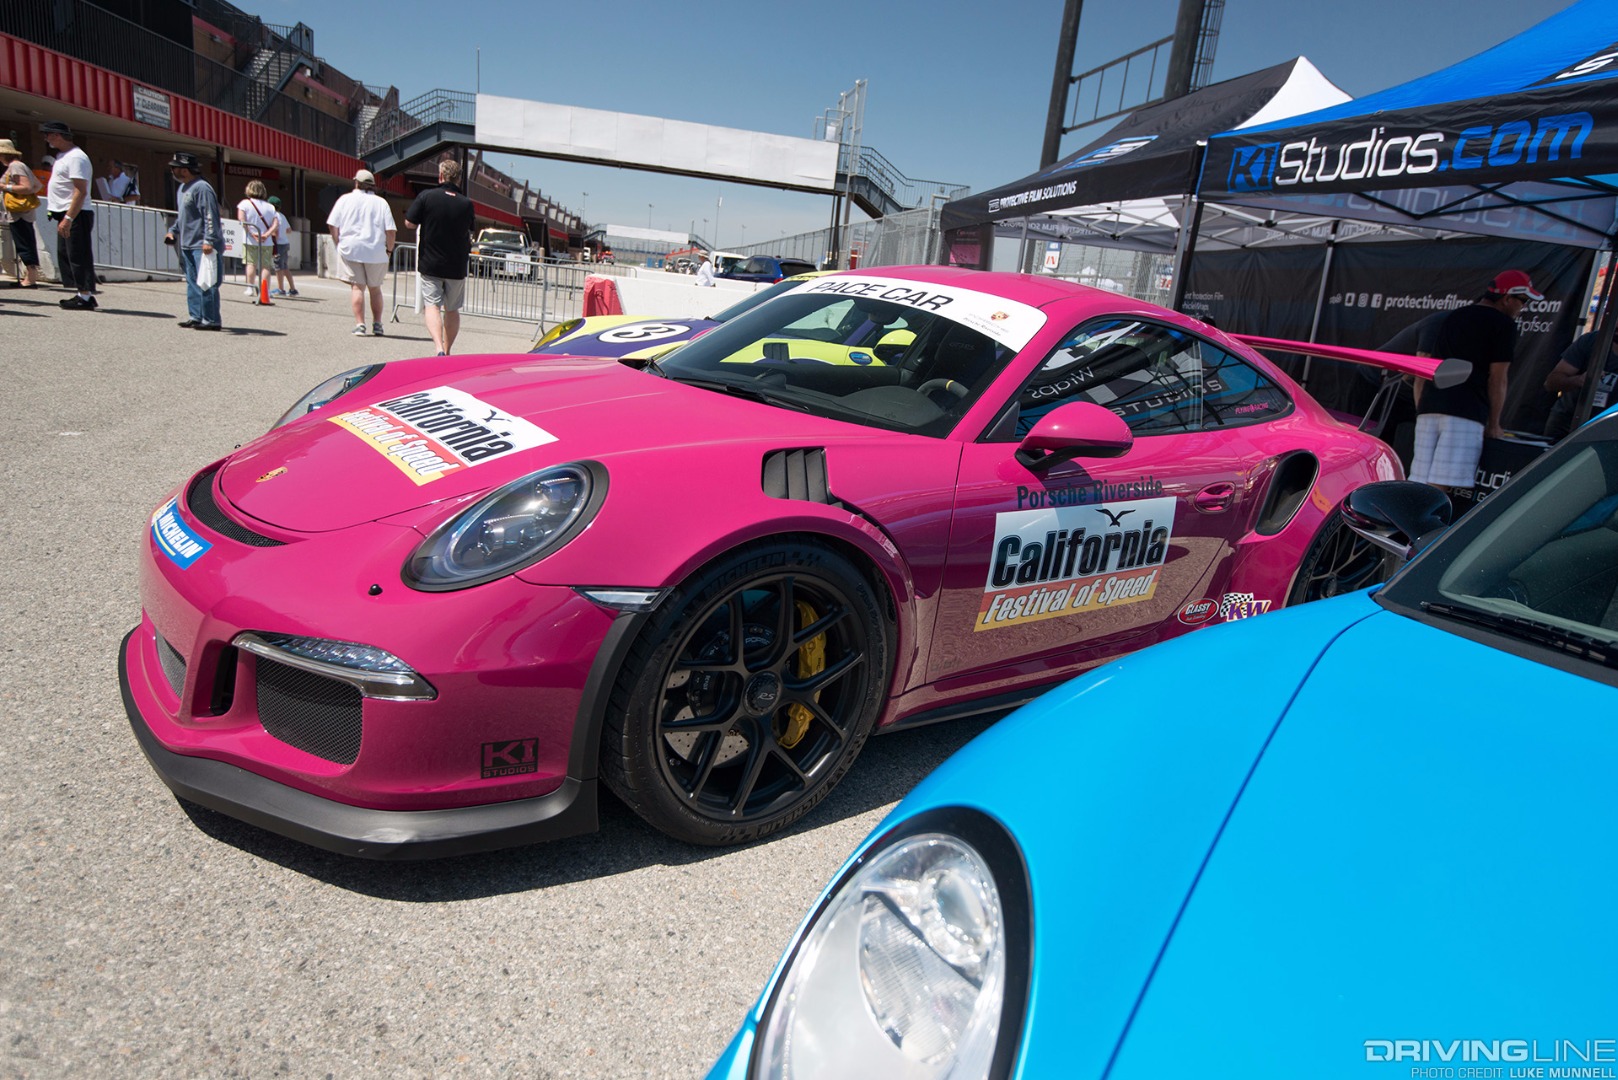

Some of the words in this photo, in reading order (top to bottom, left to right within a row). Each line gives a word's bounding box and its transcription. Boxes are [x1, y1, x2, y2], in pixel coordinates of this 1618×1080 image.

[228, 165, 263, 177] SECURITY
[1000, 191, 1029, 209] PROTECTIVE
[1028, 188, 1043, 203] FILM
[1042, 179, 1078, 200] SOLUTIONS
[806, 280, 885, 297] PACE
[880, 286, 955, 311] CAR
[612, 325, 676, 339] 3
[338, 408, 404, 435] Festival
[386, 438, 461, 477] Speed
[377, 392, 517, 463] California
[1017, 482, 1088, 509] Porsche
[1093, 475, 1163, 503] Riverside
[158, 512, 204, 559] MICHELIN
[990, 519, 1170, 589] California
[981, 579, 1077, 625] Festival
[1074, 577, 1099, 609] of
[1098, 569, 1159, 605] Speed
[1185, 602, 1211, 616] CLASSY
[1228, 601, 1272, 621] KW
[483, 766, 535, 778] STUDIOS
